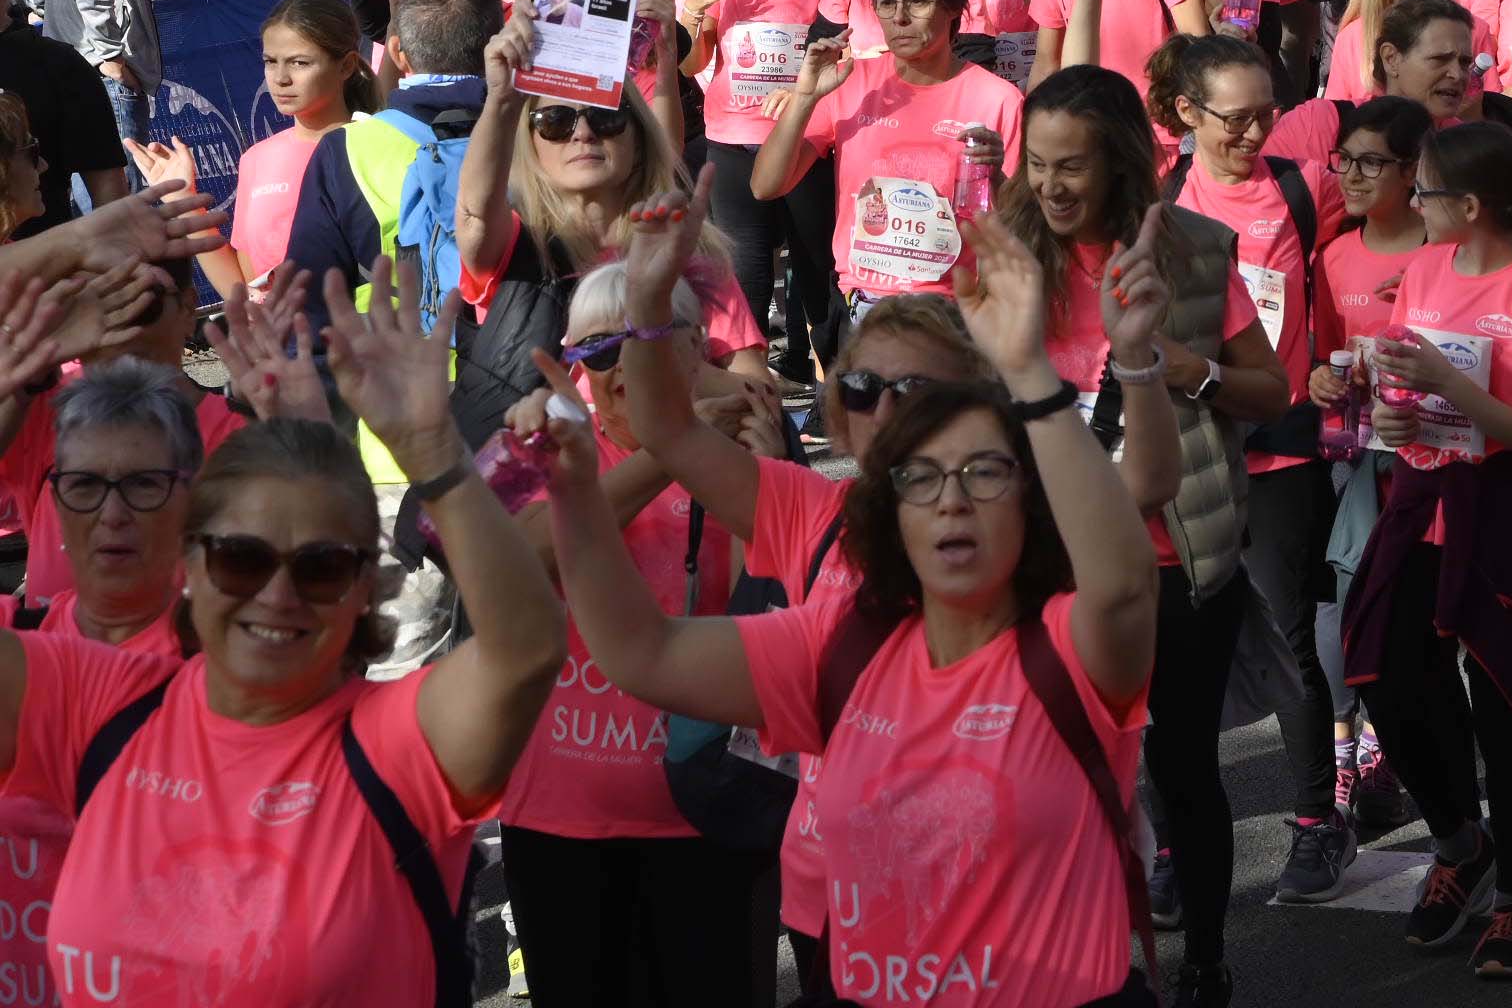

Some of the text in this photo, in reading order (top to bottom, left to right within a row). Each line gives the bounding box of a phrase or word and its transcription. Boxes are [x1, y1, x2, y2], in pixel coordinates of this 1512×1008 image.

[759, 53, 787, 64] 016
[761, 66, 784, 74] 23986
[857, 114, 899, 129] OYSHO
[892, 194, 931, 209] ASTURIANA
[891, 217, 926, 235] 016
[893, 235, 920, 248] 17642
[865, 243, 893, 254] CARRERA
[912, 250, 933, 261] MUJER
[858, 256, 892, 268] OYSHO
[551, 704, 669, 752] SUMA
[56, 942, 122, 1002] TU
[0, 962, 58, 1006] SU
